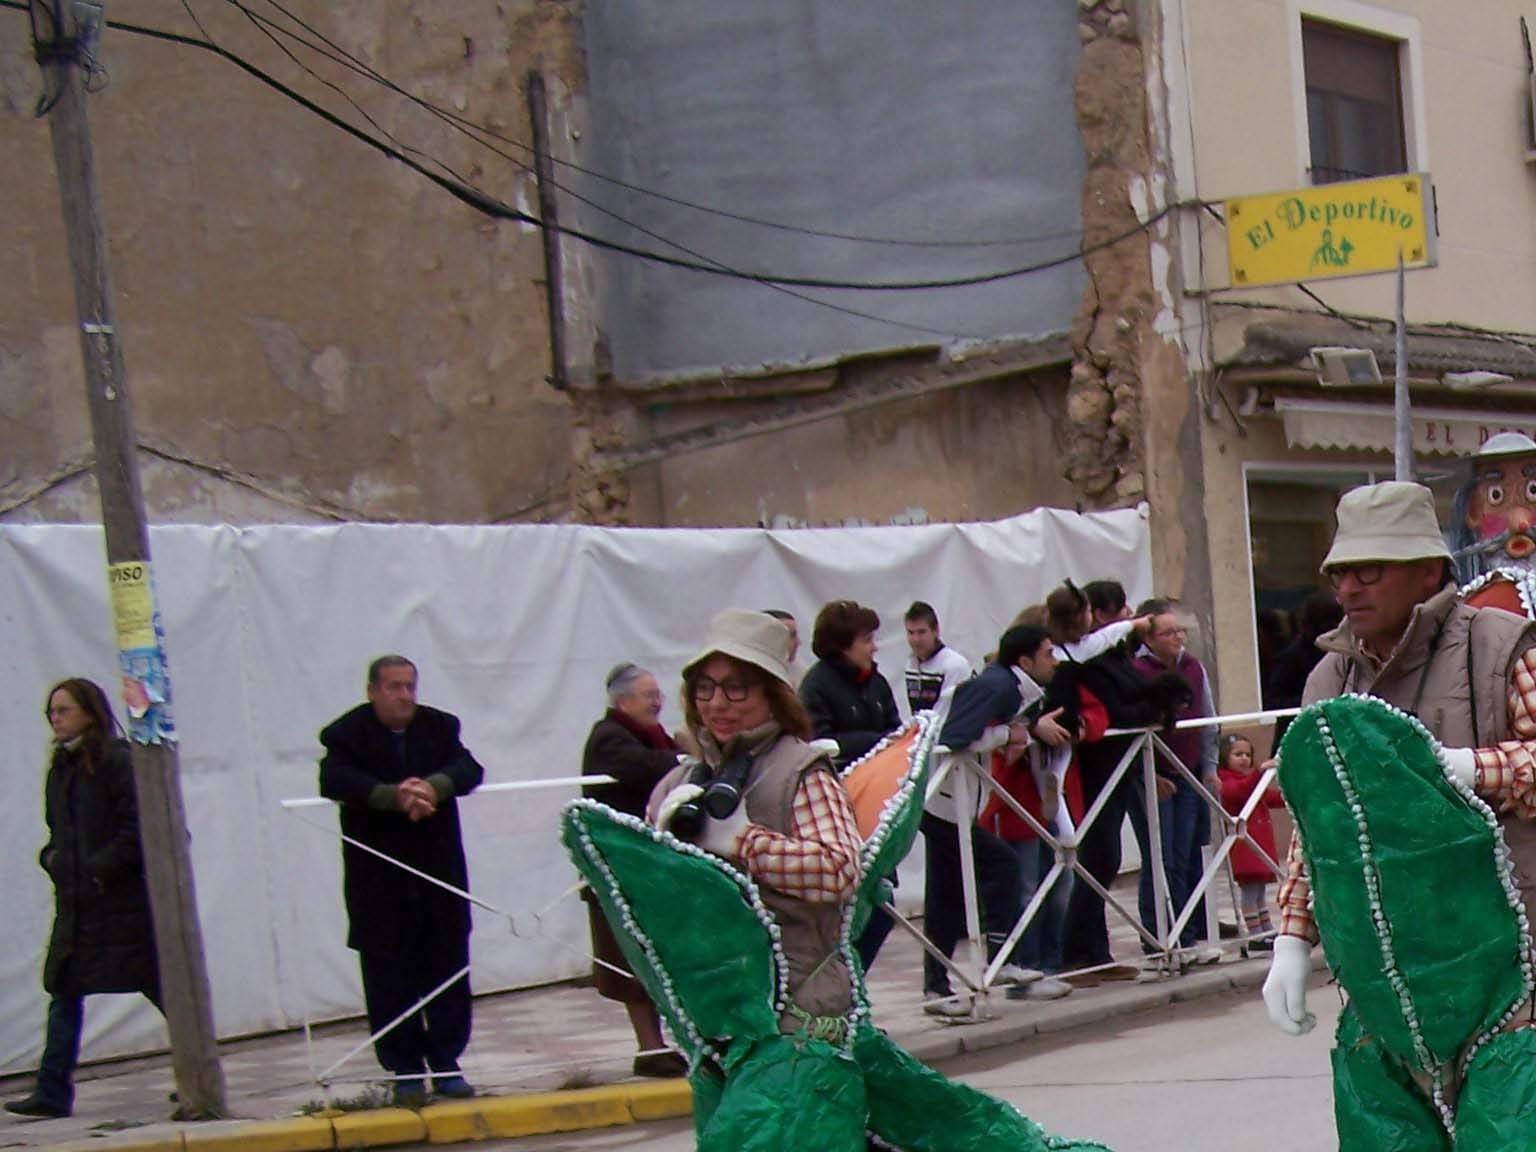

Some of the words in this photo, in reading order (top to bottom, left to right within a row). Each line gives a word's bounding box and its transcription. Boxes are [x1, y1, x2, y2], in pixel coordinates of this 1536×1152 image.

[1246, 219, 1276, 250] El
[1276, 196, 1415, 231] Deportivo
[1425, 422, 1454, 446] EL
